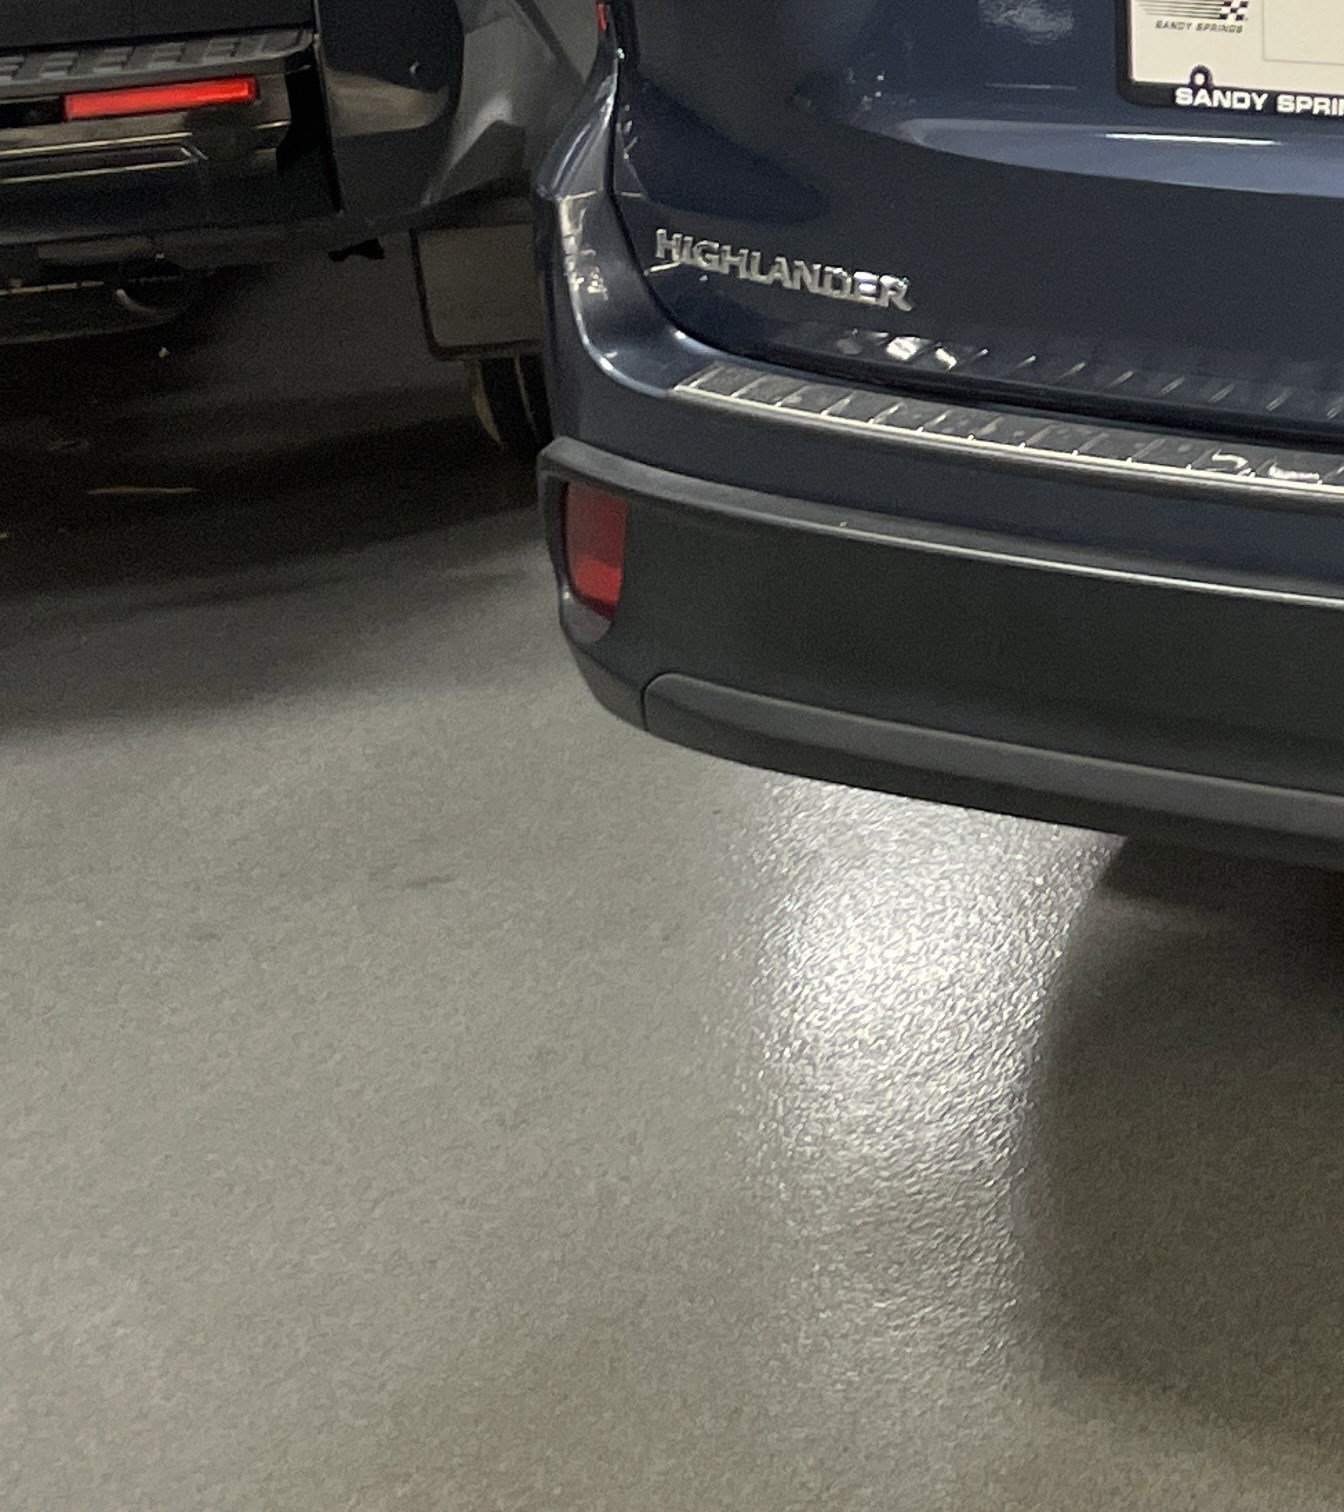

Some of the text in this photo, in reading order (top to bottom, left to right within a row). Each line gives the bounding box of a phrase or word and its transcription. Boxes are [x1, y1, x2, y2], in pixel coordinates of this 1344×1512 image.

[1155, 19, 1244, 34] SANDY SPRINGS
[1174, 87, 1269, 111] SANDY
[655, 228, 914, 312] HIGHLANDER
